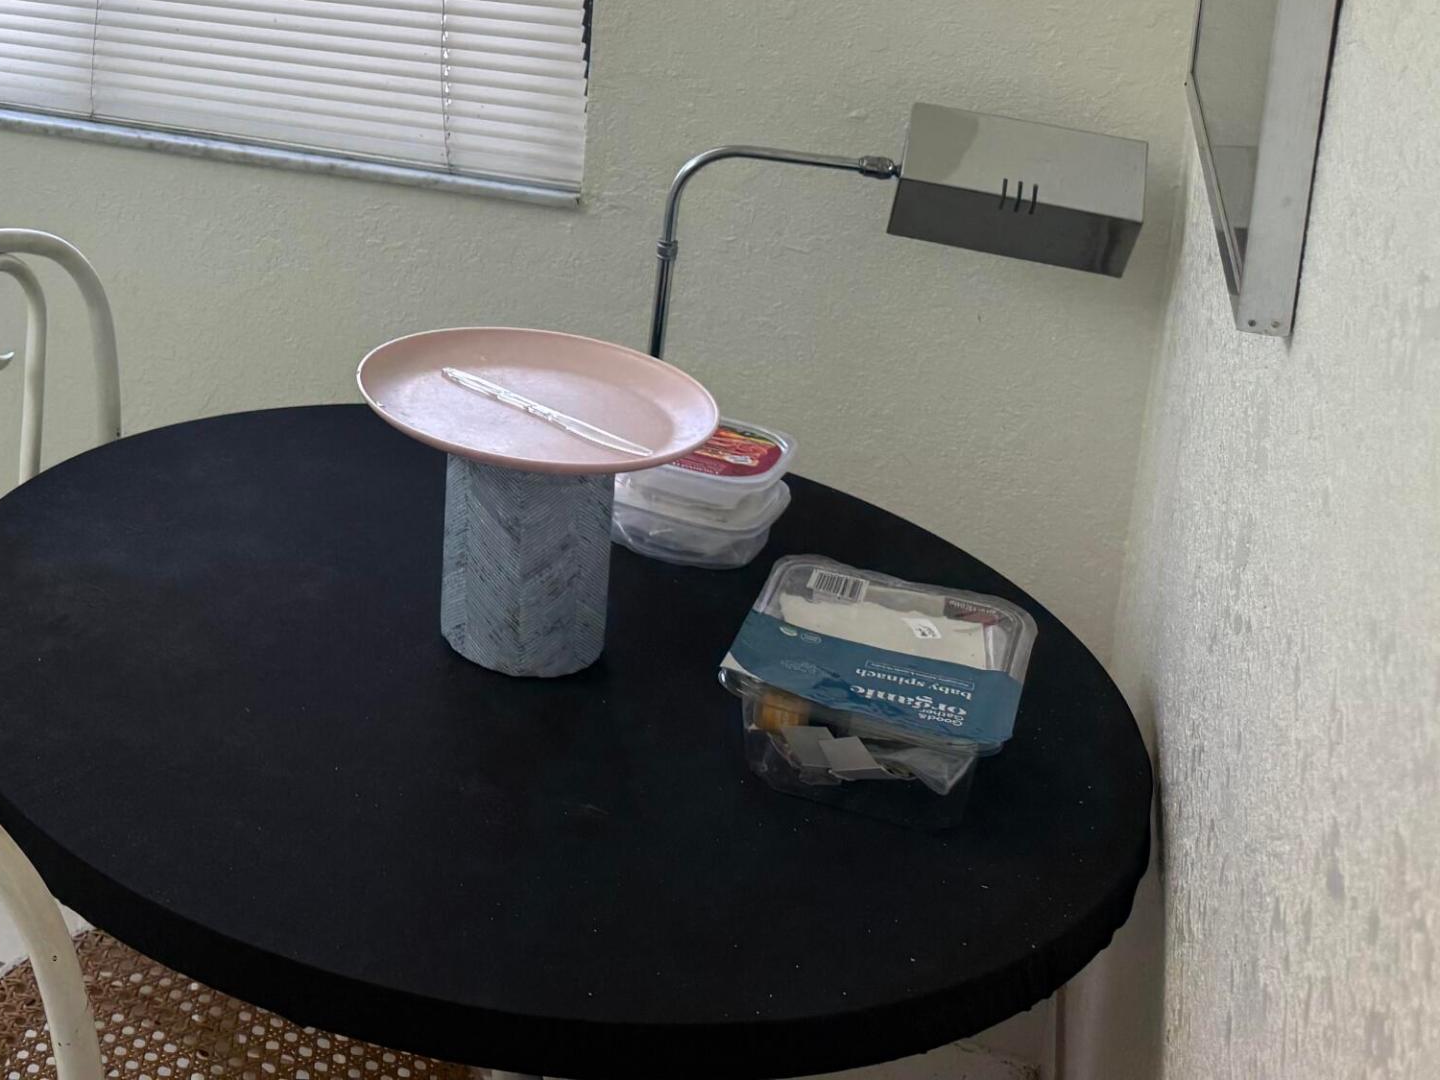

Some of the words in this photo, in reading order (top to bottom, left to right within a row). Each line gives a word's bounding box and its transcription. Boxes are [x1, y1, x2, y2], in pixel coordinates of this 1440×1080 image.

[854, 667, 927, 690] spinach
[848, 683, 968, 718] organic
[928, 680, 974, 701] baby
[918, 706, 965, 721] Gather
